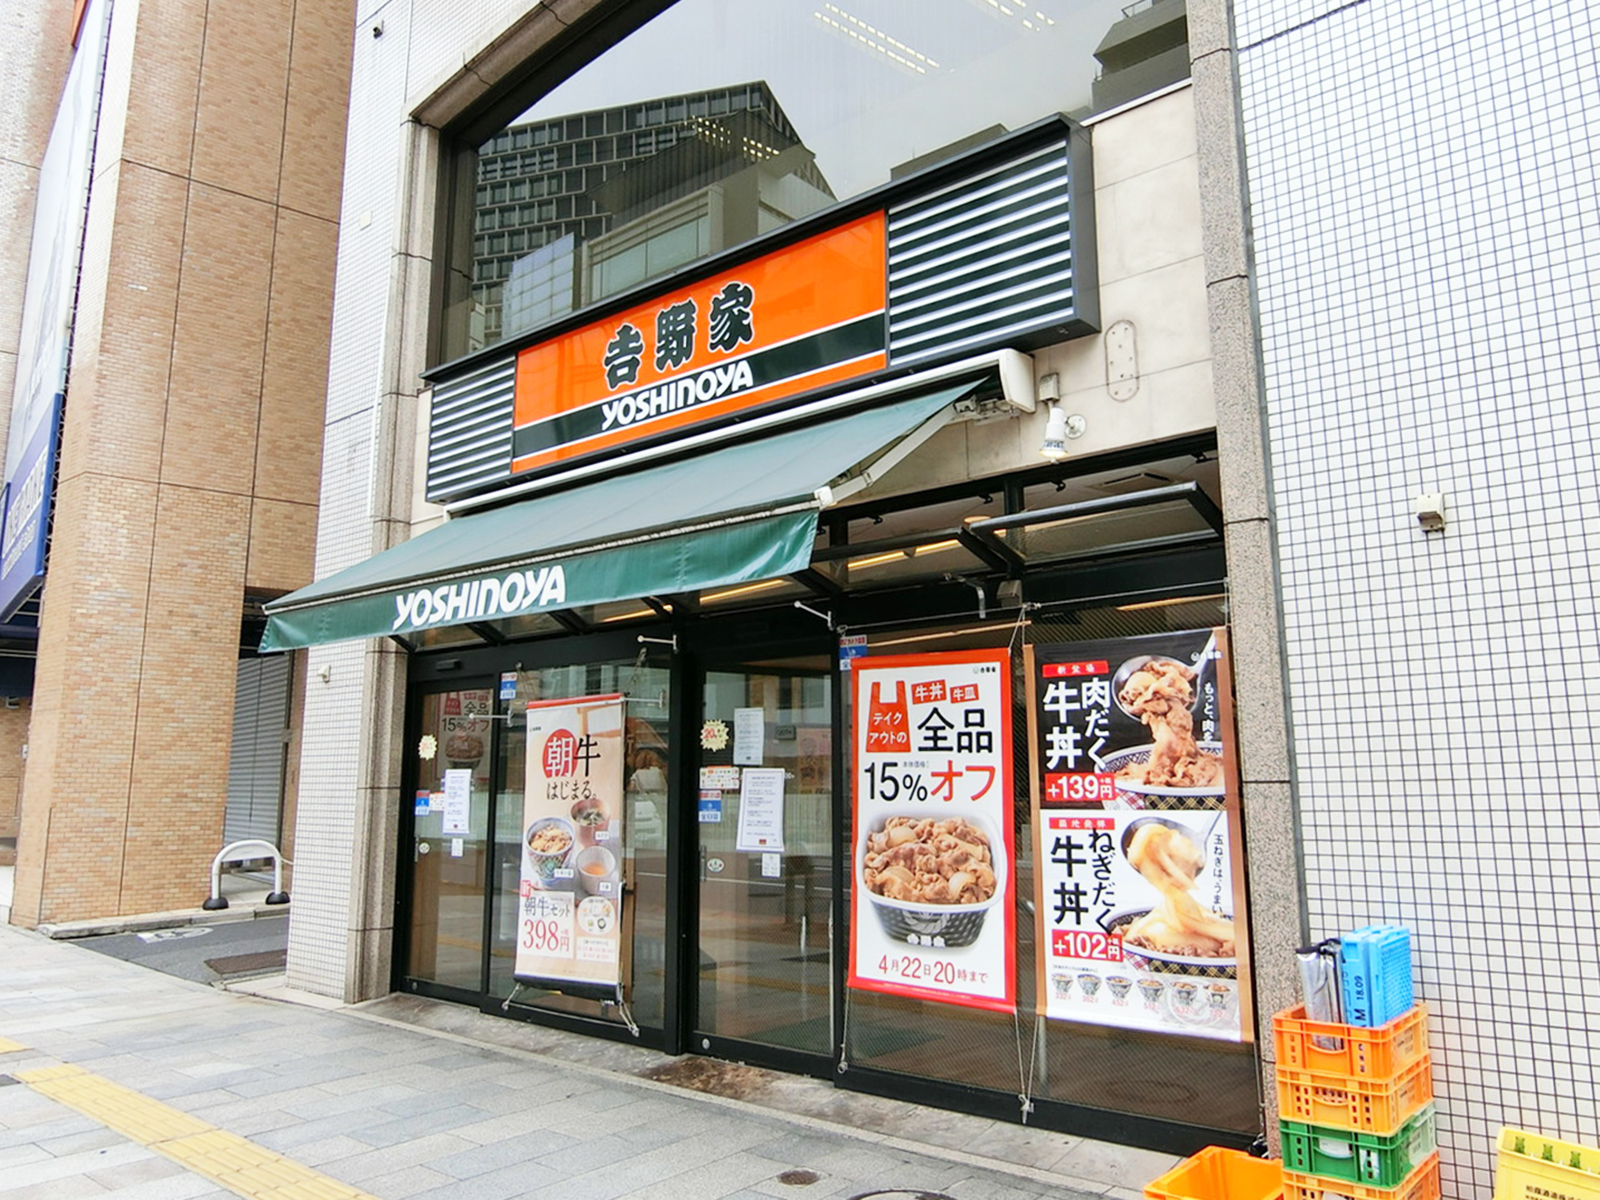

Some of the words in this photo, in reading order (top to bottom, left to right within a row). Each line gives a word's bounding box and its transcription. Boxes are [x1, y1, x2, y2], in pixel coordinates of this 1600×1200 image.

[603, 281, 754, 391] 吉野家
[601, 360, 754, 431] YOSHINOYA
[392, 565, 567, 632] YOSHINOYA
[873, 711, 903, 726] テイク
[914, 683, 944, 702] 牛丼
[952, 686, 977, 701] 牛皿
[868, 731, 908, 745] アウトの
[917, 706, 993, 754] 全品
[1043, 681, 1083, 770] 牛丼
[1081, 677, 1111, 770] 肉だく
[545, 734, 601, 778] 朝牛
[546, 780, 597, 801] はじまる。
[1051, 835, 1089, 926] 牛丼
[1087, 828, 1117, 936] ねぎだく
[878, 954, 989, 984] 4月22日20時まで
